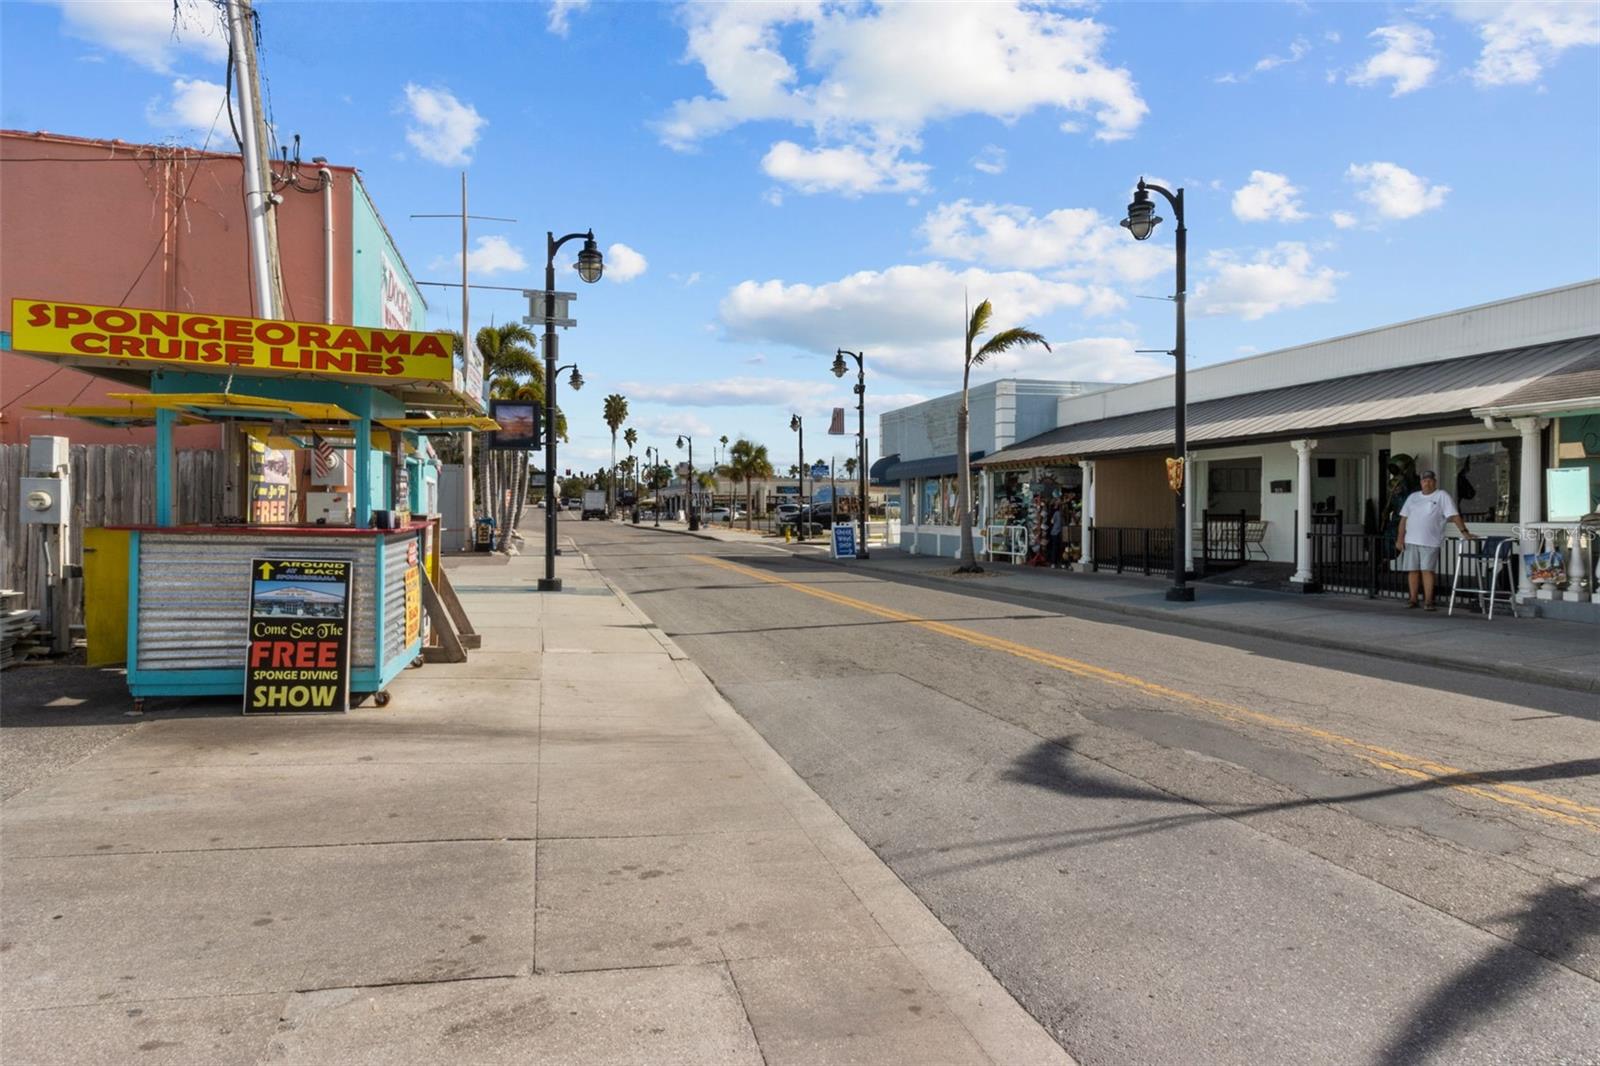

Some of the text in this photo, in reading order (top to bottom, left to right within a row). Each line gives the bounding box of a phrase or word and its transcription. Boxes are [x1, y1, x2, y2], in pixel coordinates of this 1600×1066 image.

[26, 303, 449, 358] SPONGEORAMA
[70, 332, 405, 375] CRUISE LINES
[252, 501, 286, 522] FREE
[279, 561, 345, 569] AROUND
[253, 622, 344, 639] Come See The
[251, 641, 338, 668] FREE
[253, 670, 338, 681] SPONGE DIVING
[253, 685, 337, 707] SHOW
